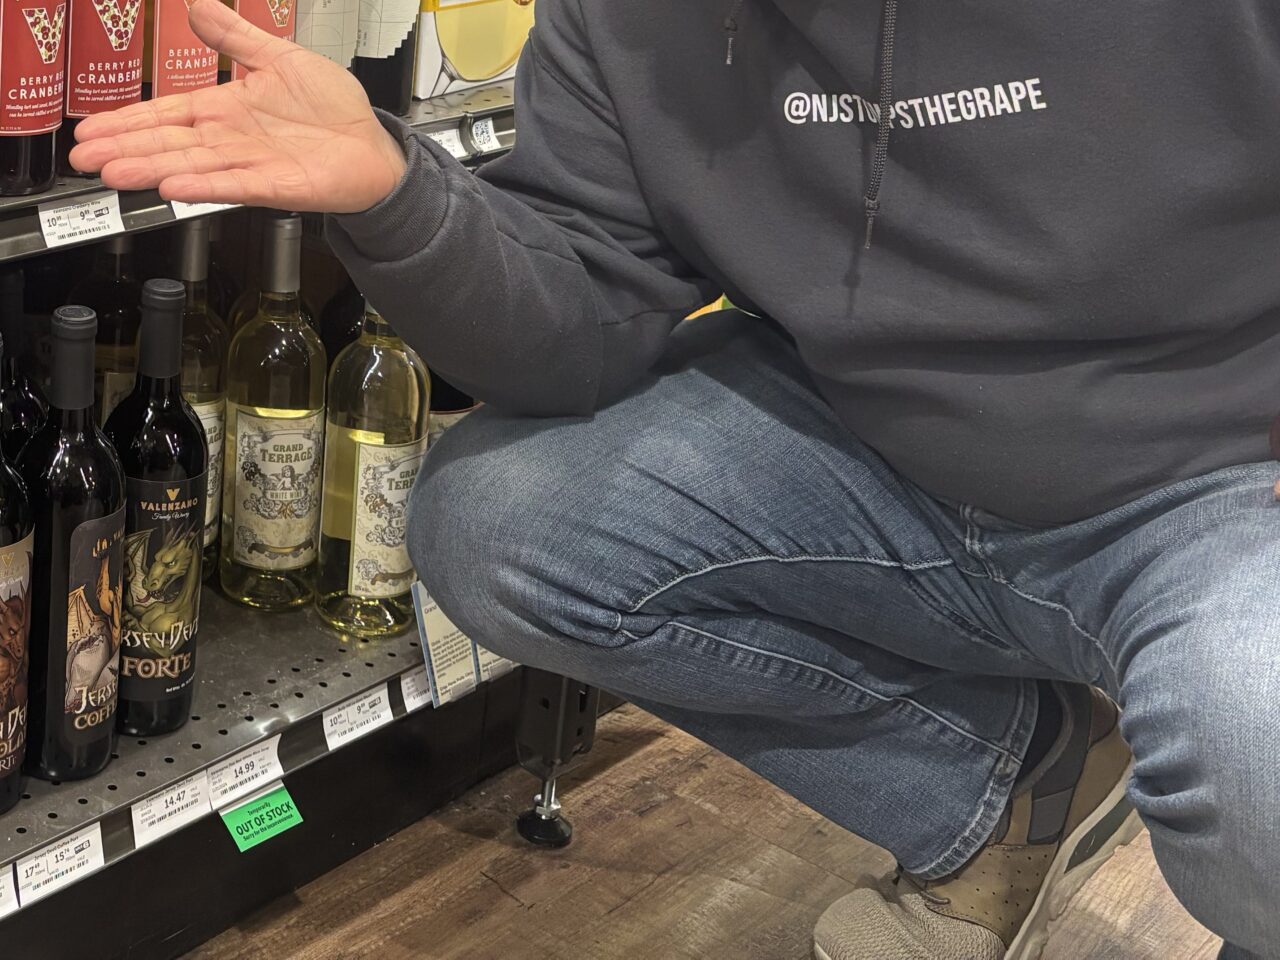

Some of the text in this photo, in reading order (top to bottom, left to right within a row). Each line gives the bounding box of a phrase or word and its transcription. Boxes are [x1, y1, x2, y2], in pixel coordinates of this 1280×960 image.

[169, 46, 202, 57] BERRY
[89, 58, 141, 71] BERRY RED
[20, 74, 53, 86] BERRY
[273, 443, 304, 453] GRAND
[270, 491, 288, 499] WHITE
[140, 498, 198, 511] VALENZANO
[121, 652, 192, 679] FORTE
[234, 761, 255, 779] 14.99
[163, 790, 186, 809] 14.47
[235, 800, 294, 836] OUT OF STOCK
